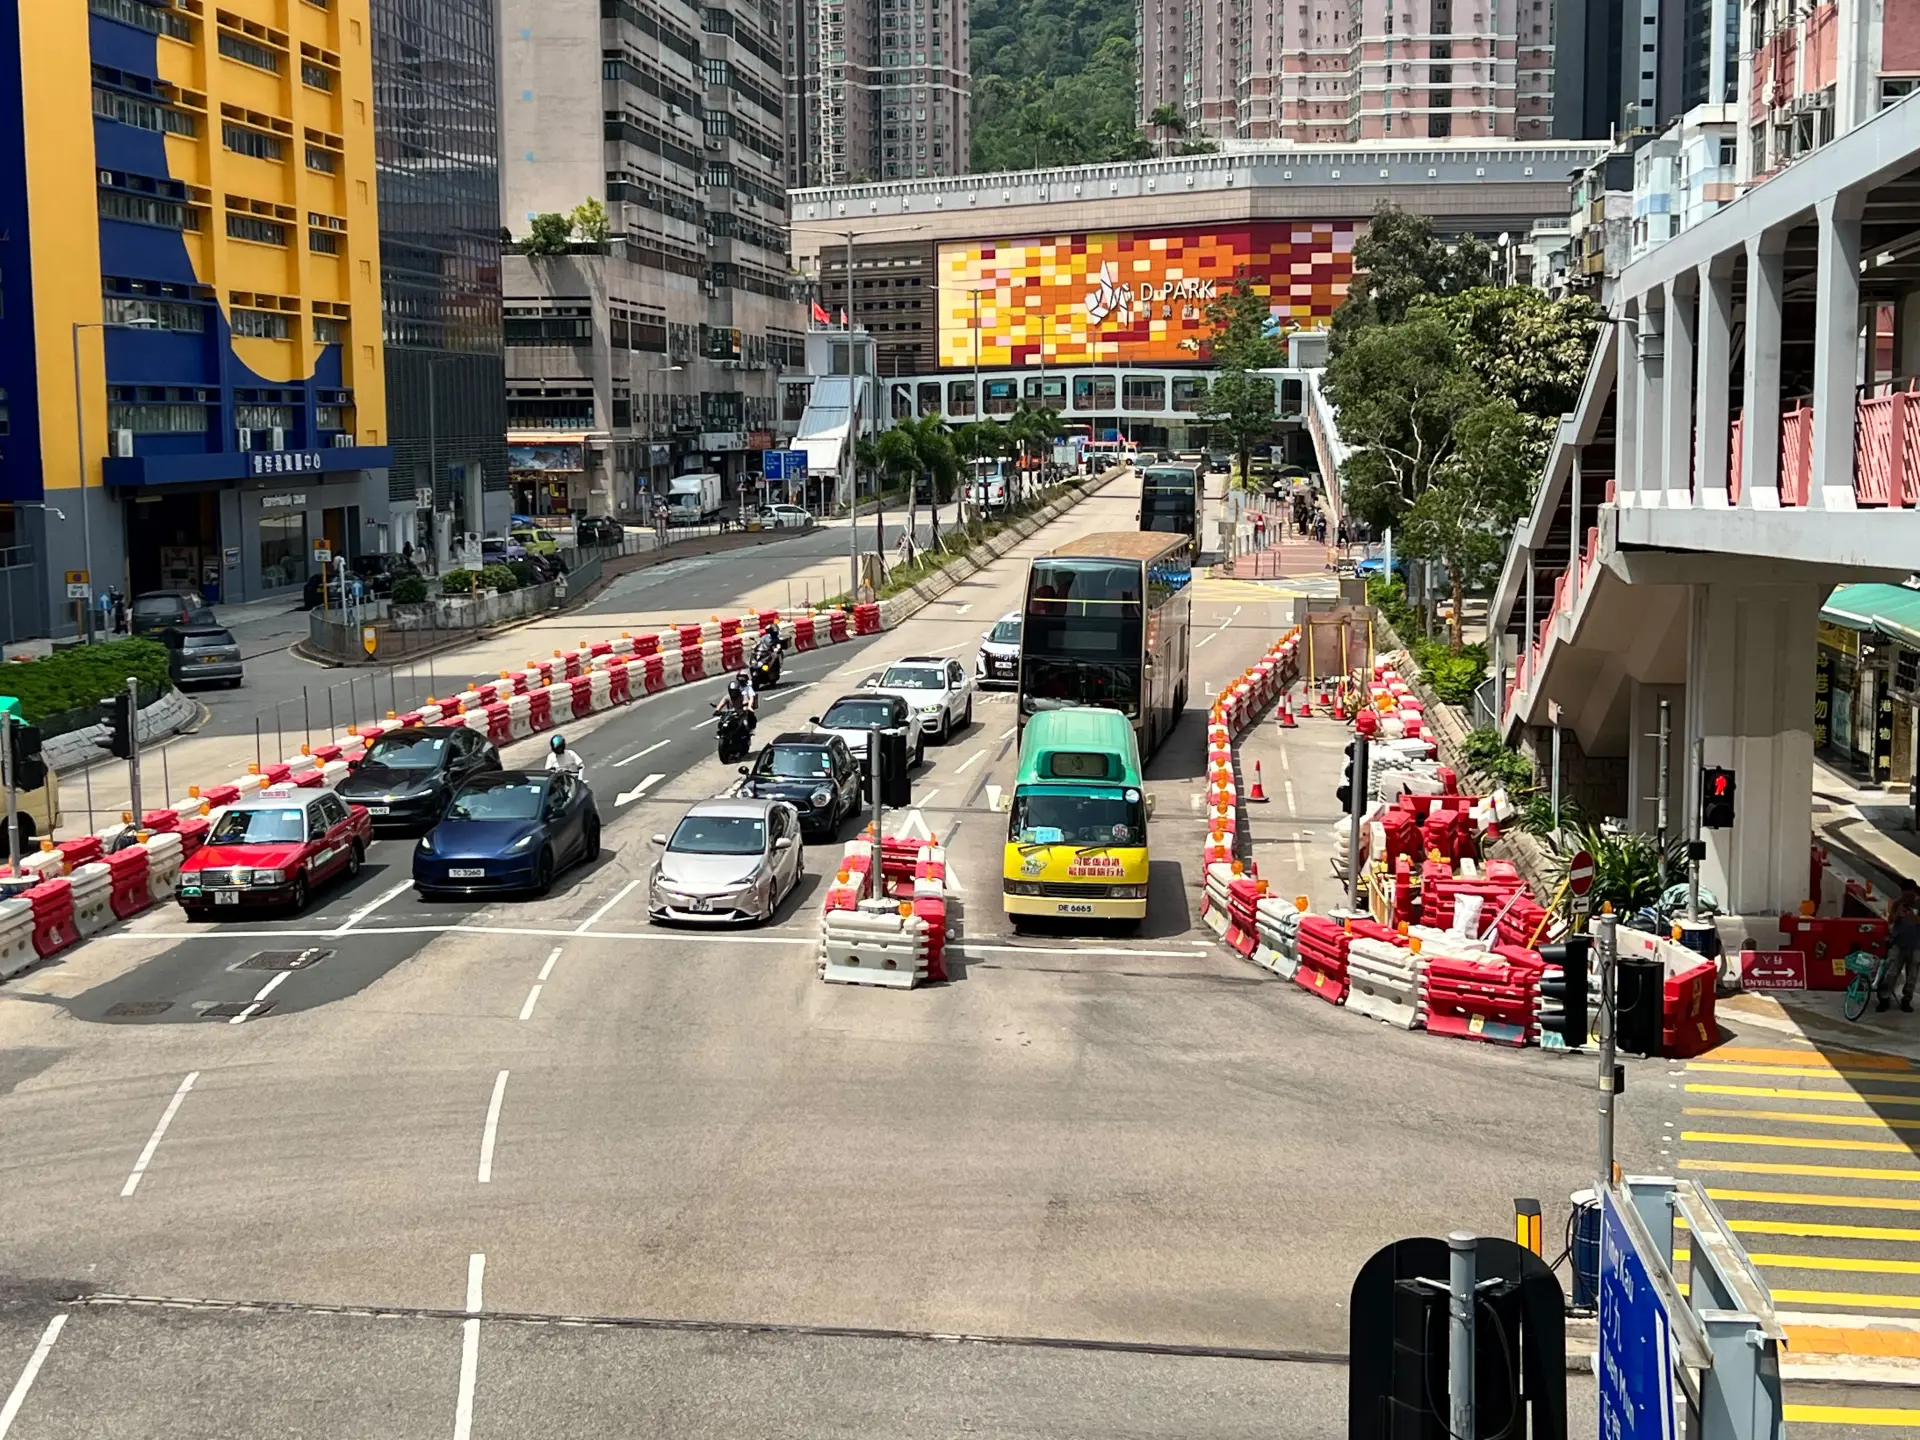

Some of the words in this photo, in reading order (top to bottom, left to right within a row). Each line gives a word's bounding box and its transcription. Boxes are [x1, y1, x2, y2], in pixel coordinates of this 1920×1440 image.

[1058, 904, 1068, 912] DE
[1744, 978, 1804, 987] PEDESTRIANS
[1619, 1248, 1634, 1304] Kau
[1619, 1368, 1635, 1432] Mun
